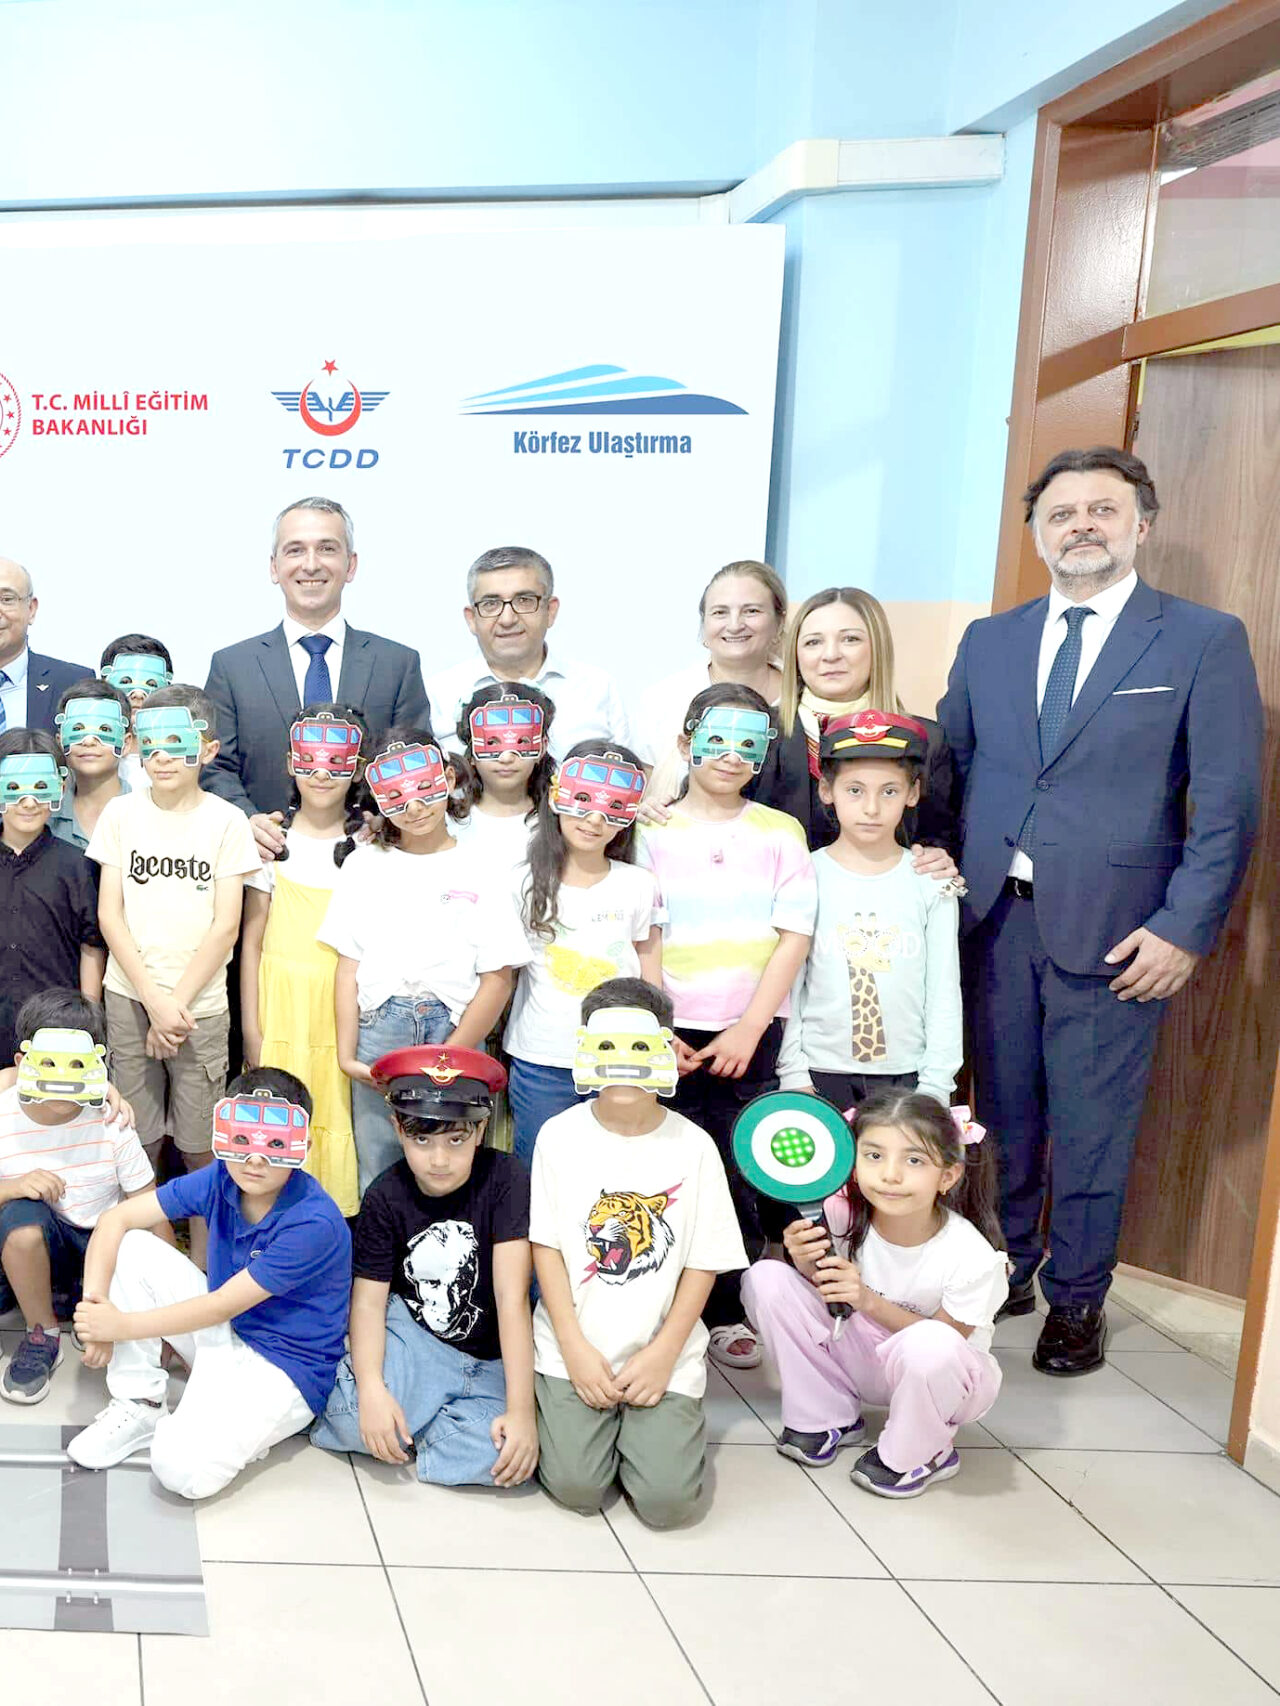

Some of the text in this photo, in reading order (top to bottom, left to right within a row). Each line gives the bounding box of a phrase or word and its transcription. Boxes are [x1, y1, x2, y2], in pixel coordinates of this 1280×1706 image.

[32, 393, 67, 410] T.C.
[136, 390, 209, 410] EĞİTİM
[33, 415, 147, 435] BAKANLIĞI
[513, 431, 692, 458] Körfez Ulaştırma
[282, 448, 380, 469] TCDD
[127, 850, 211, 885] Lacoste
